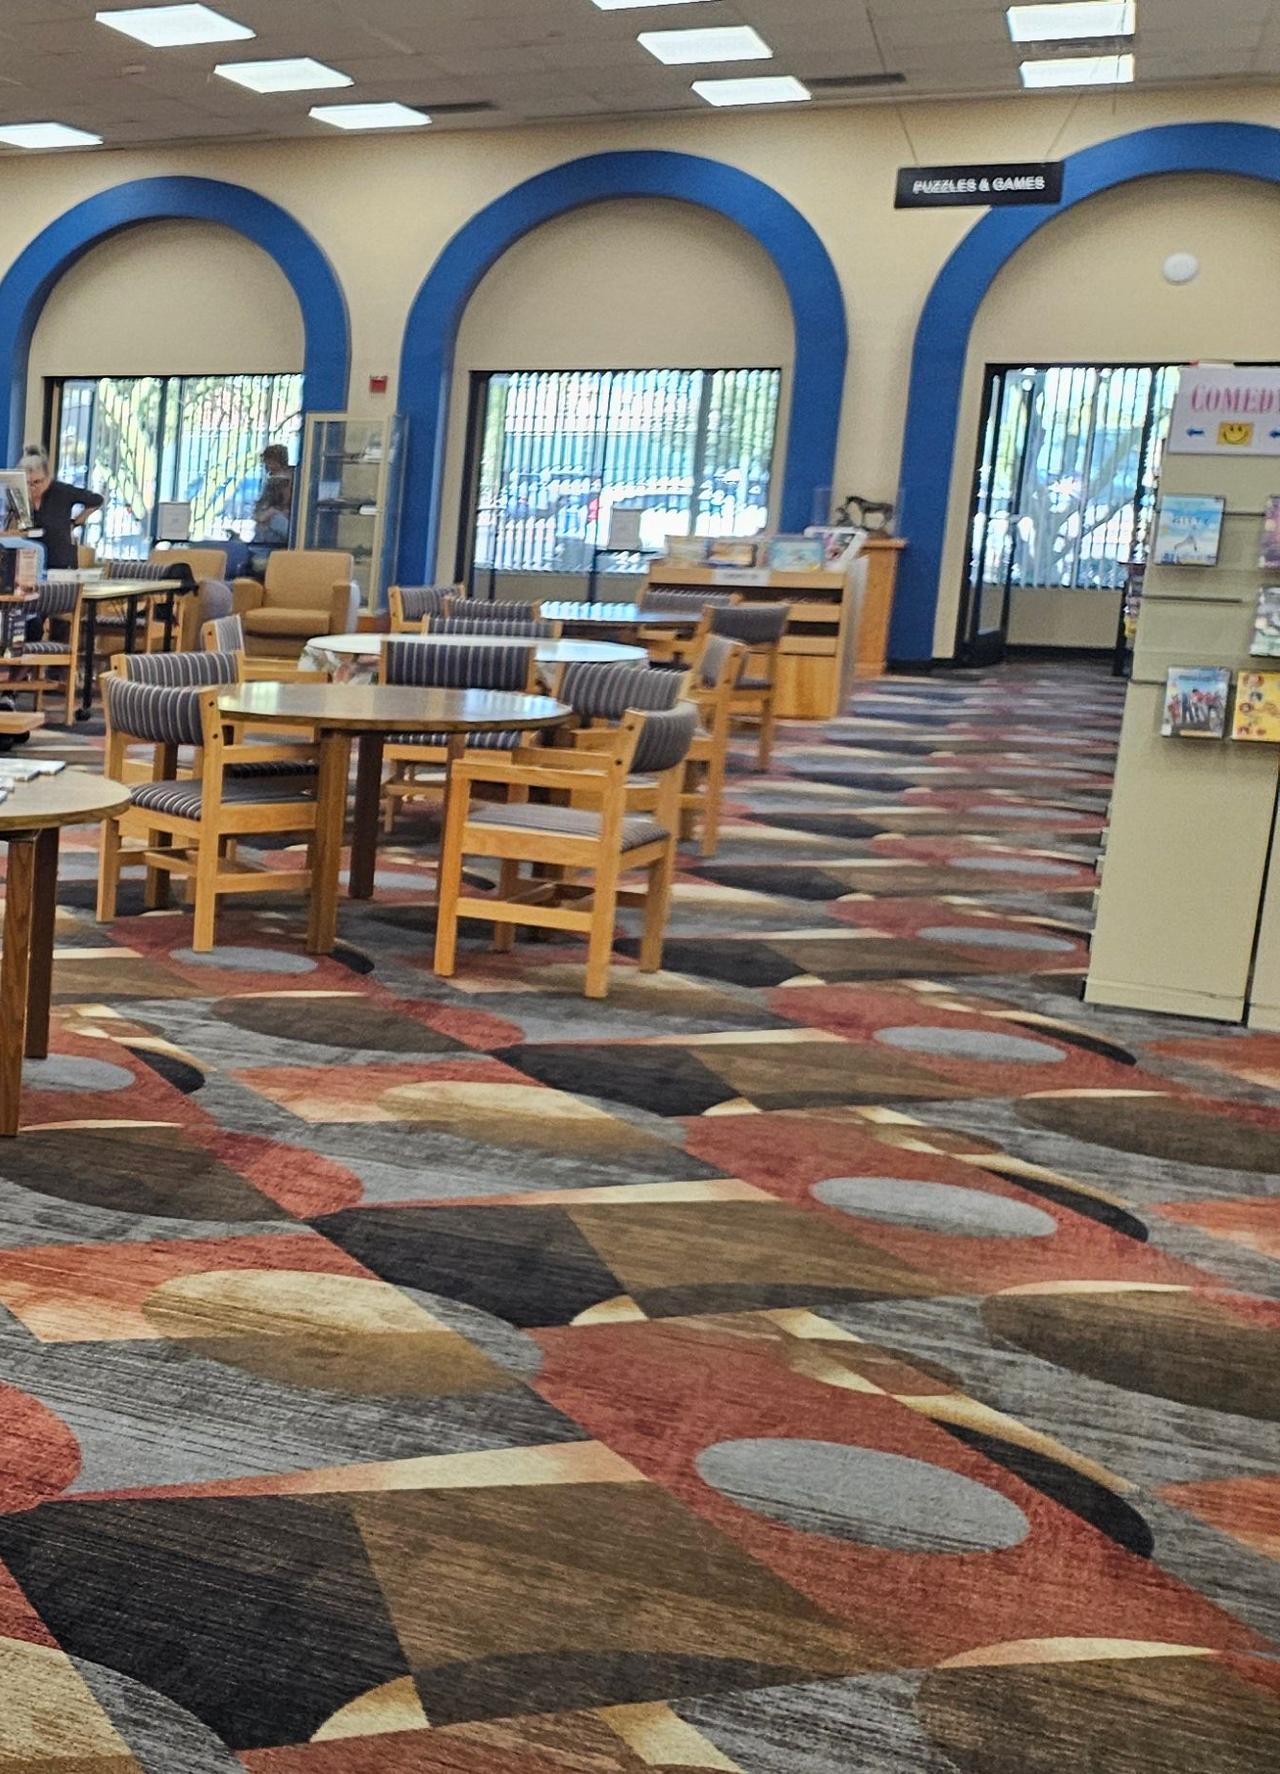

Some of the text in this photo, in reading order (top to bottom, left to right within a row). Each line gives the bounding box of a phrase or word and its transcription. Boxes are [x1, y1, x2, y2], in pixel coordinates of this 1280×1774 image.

[913, 176, 1045, 194] PUZZLES & GAMES
[1190, 384, 1280, 413] COMED
